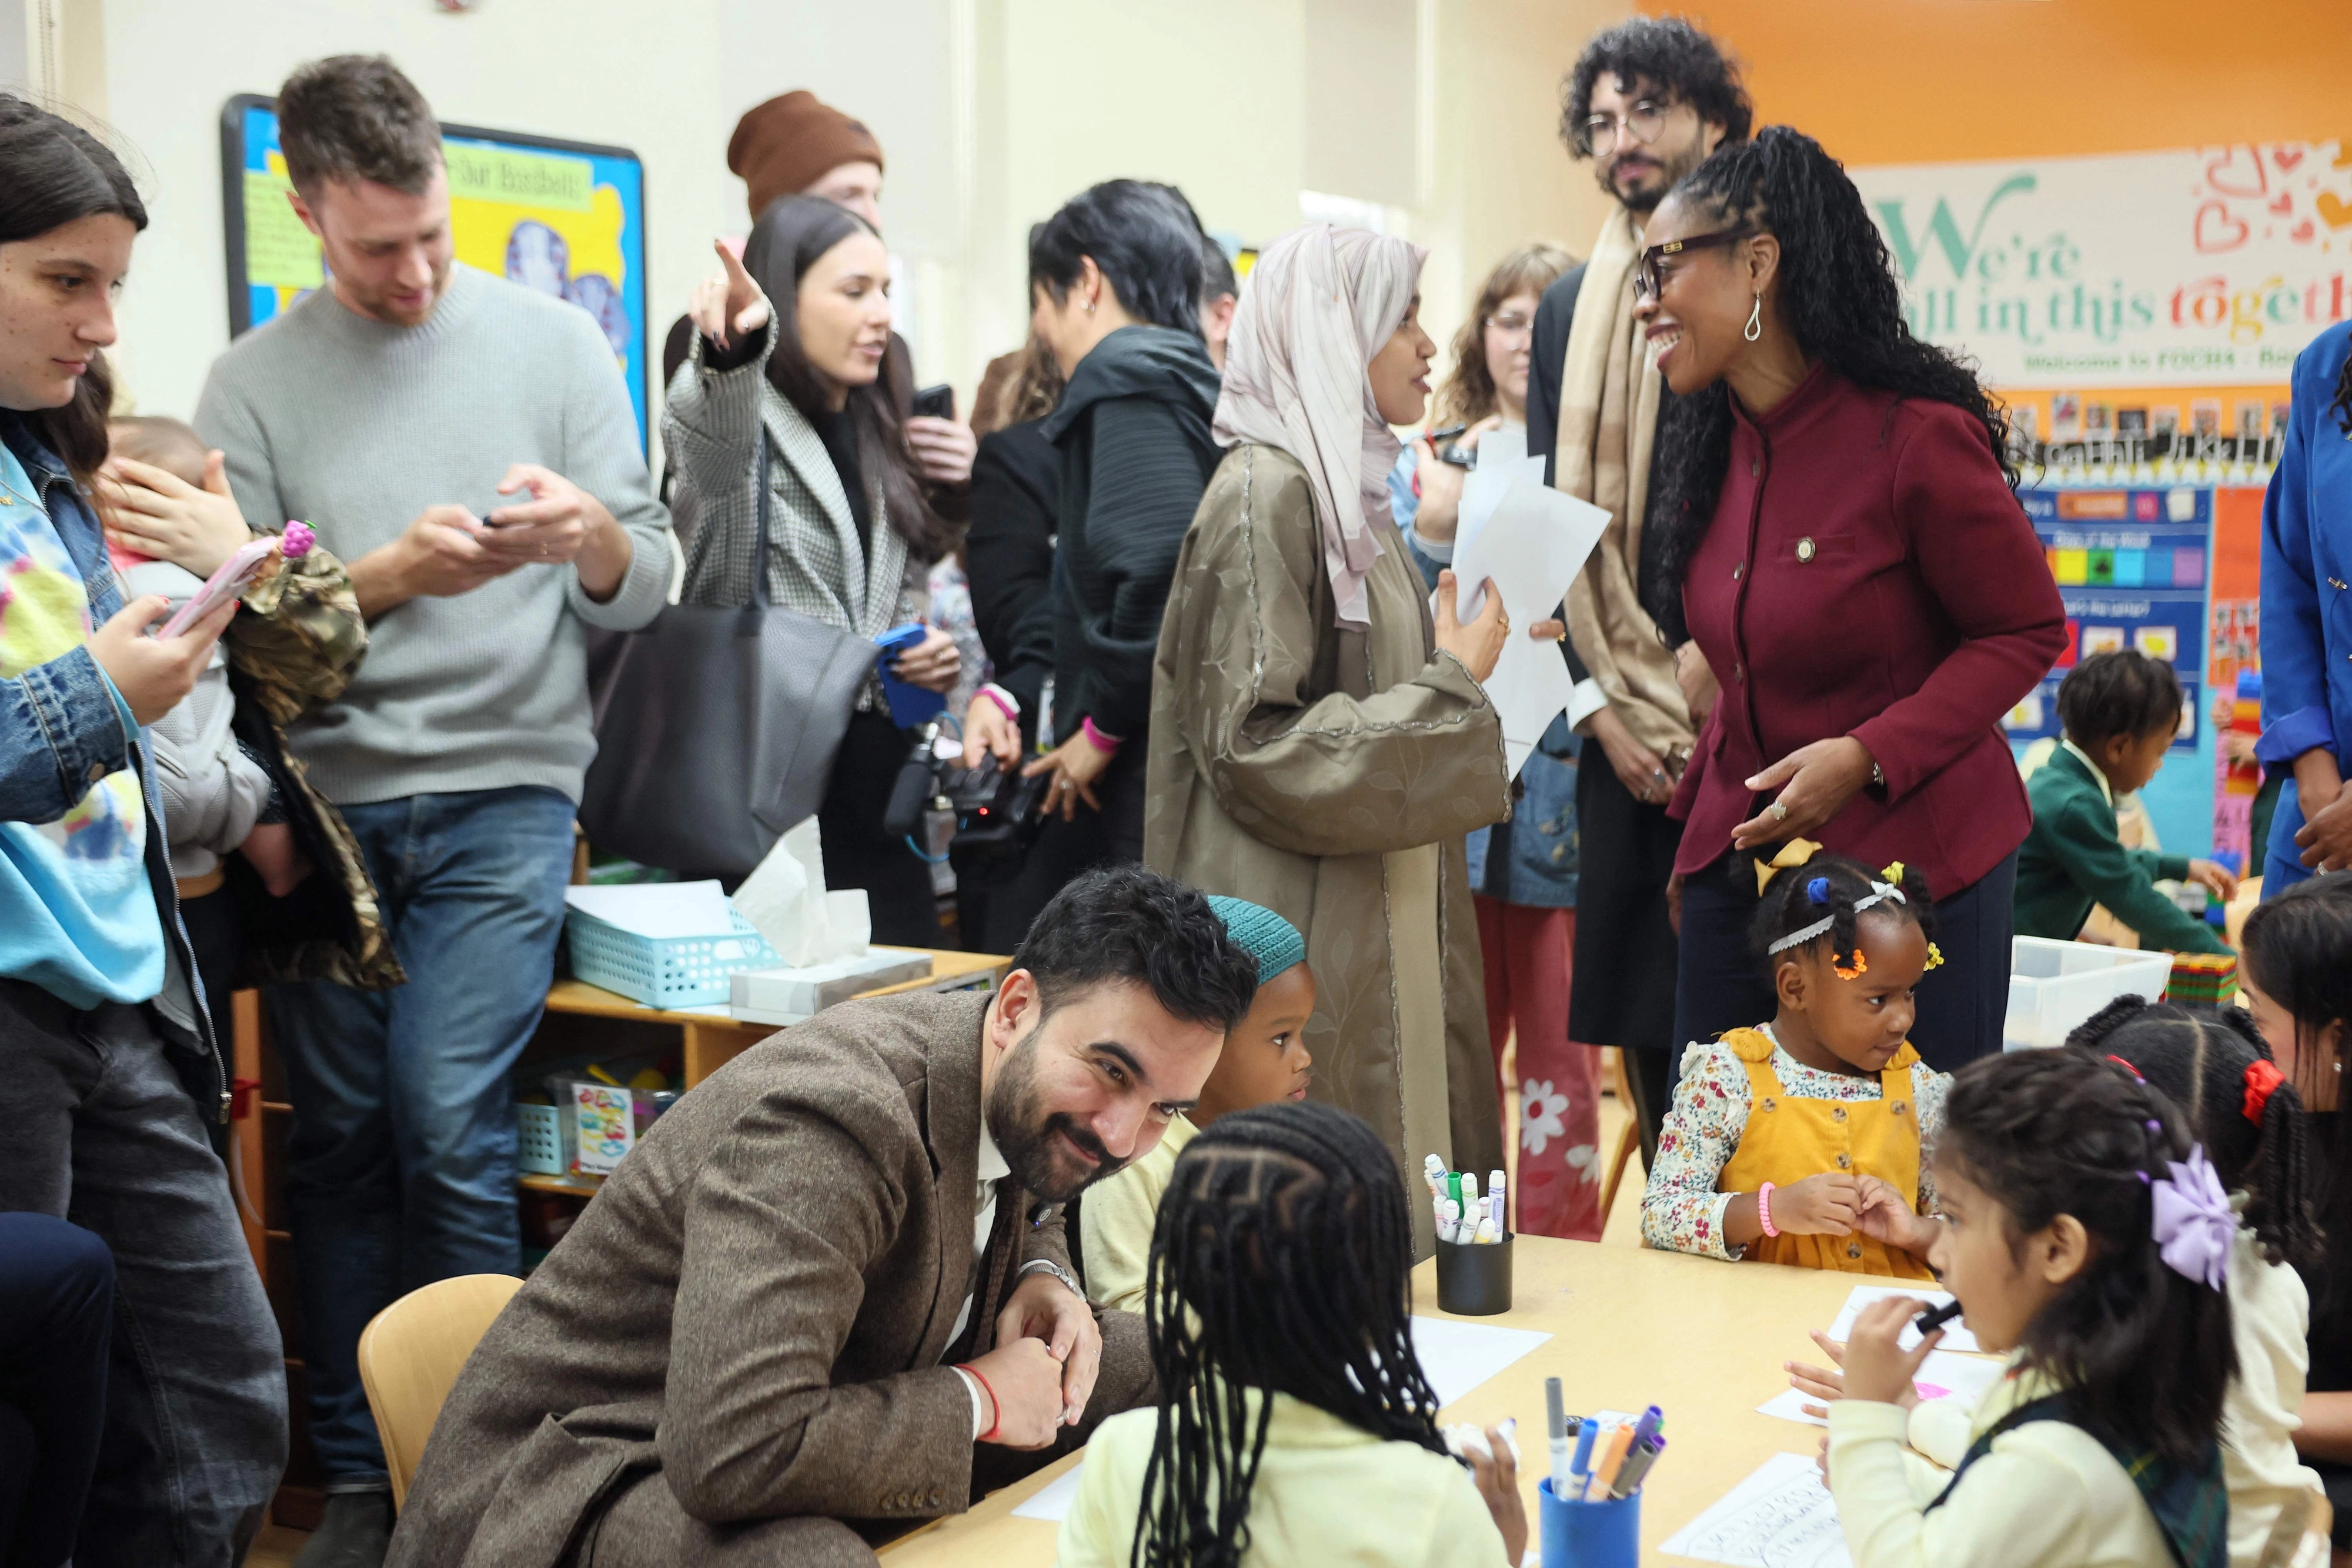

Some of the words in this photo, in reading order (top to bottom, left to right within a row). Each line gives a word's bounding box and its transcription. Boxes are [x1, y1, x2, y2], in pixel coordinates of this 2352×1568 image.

[1874, 174, 2082, 280] We're
[1977, 286, 2044, 347] in
[2047, 282, 2157, 346] this
[2024, 355, 2120, 374] Welcome
